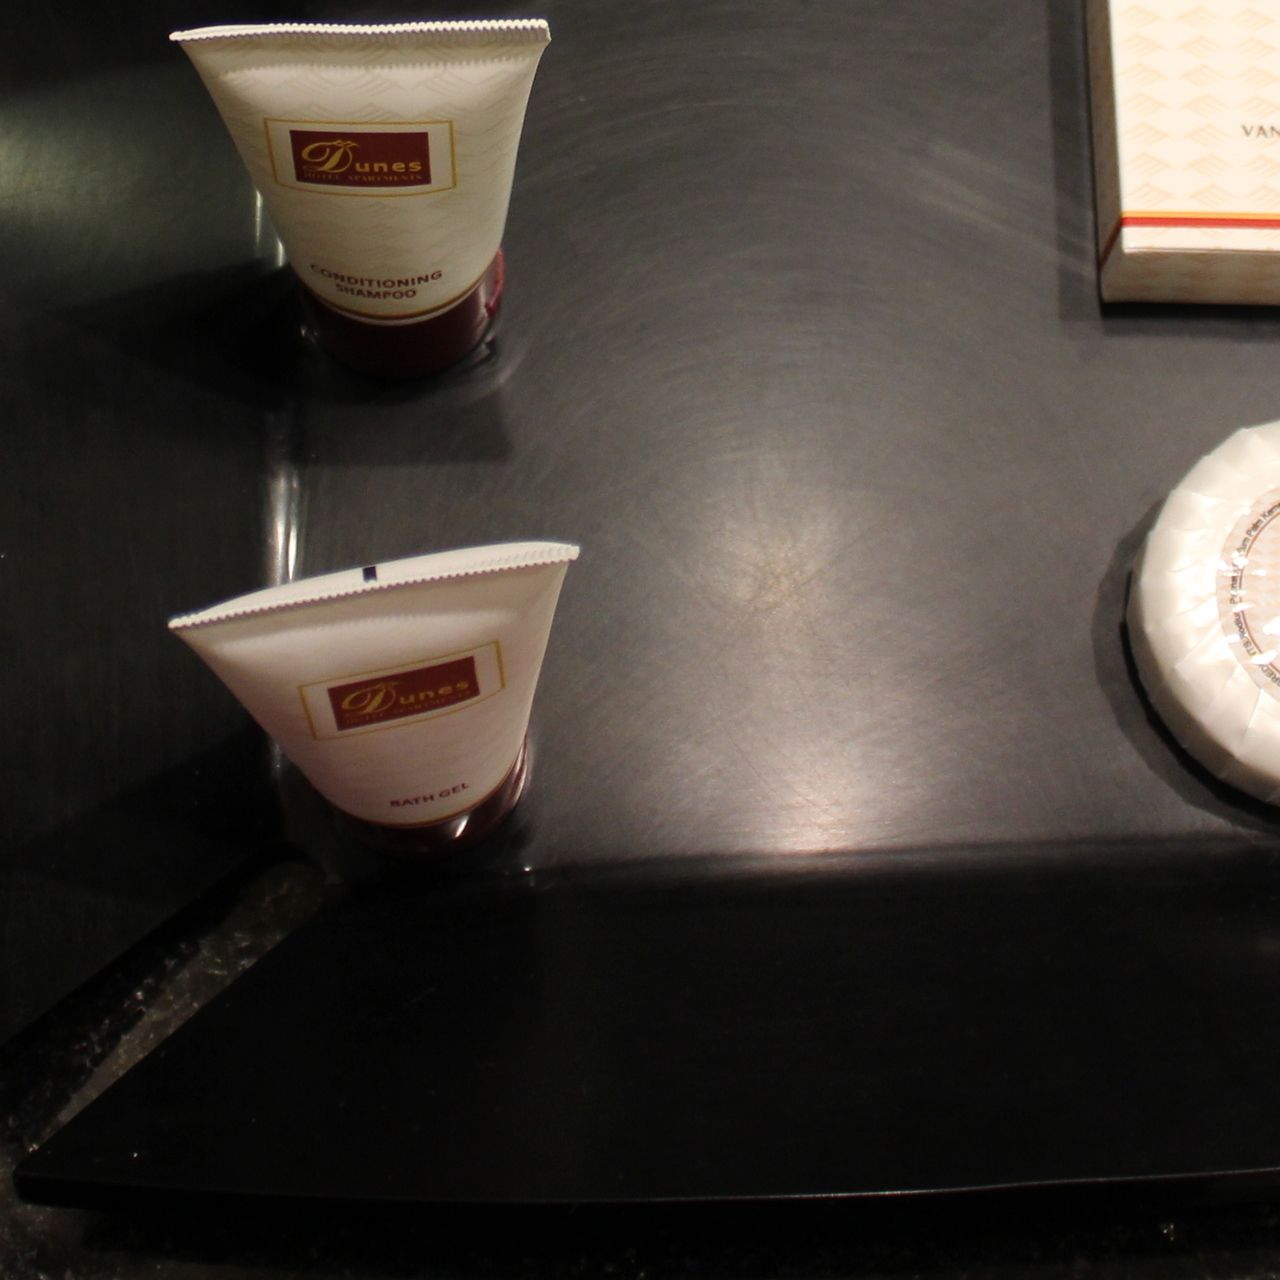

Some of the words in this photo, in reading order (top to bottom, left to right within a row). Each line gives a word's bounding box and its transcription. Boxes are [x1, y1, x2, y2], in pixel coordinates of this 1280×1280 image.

[301, 139, 423, 174] Dunes
[309, 263, 443, 289] CONDITIONING
[335, 283, 417, 300] SHAMPOO
[341, 679, 470, 715] Dunes
[390, 794, 435, 807] BATH
[439, 783, 470, 798] GEL
